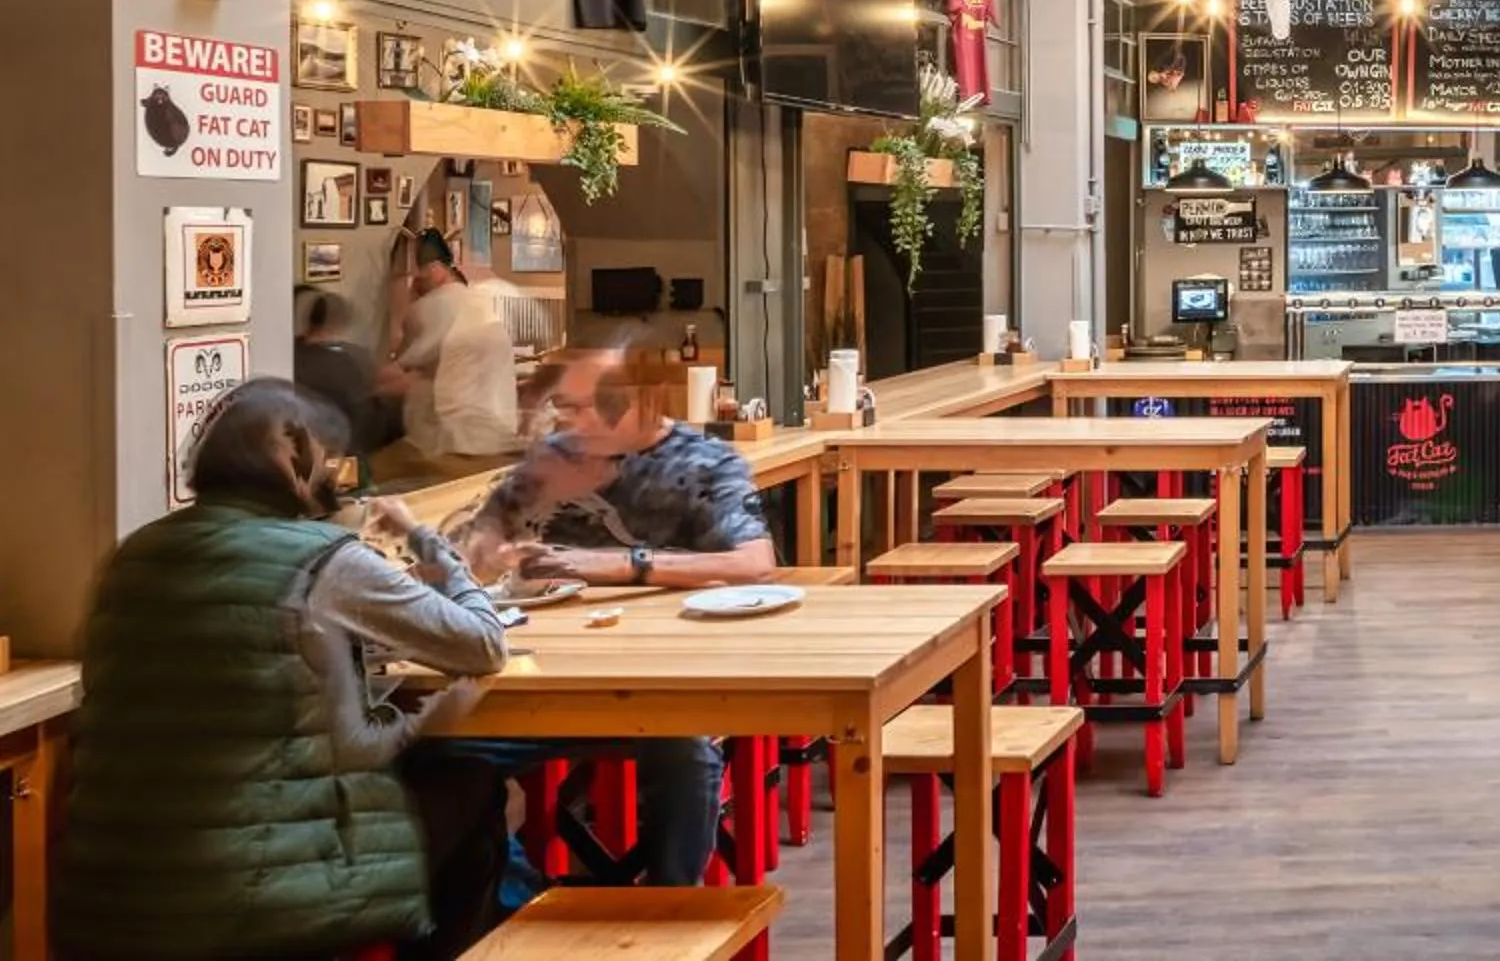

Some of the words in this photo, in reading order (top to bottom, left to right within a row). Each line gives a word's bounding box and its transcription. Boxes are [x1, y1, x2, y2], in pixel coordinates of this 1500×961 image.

[143, 32, 273, 78] BEWARE!
[1348, 48, 1387, 62] OUR
[200, 82, 268, 108] GUARD
[197, 114, 232, 136] FAT
[236, 118, 271, 138] CAT
[191, 146, 222, 168] ON
[226, 148, 277, 170] DUTY
[179, 378, 236, 394] DODGE
[1388, 443, 1420, 466] Fat
